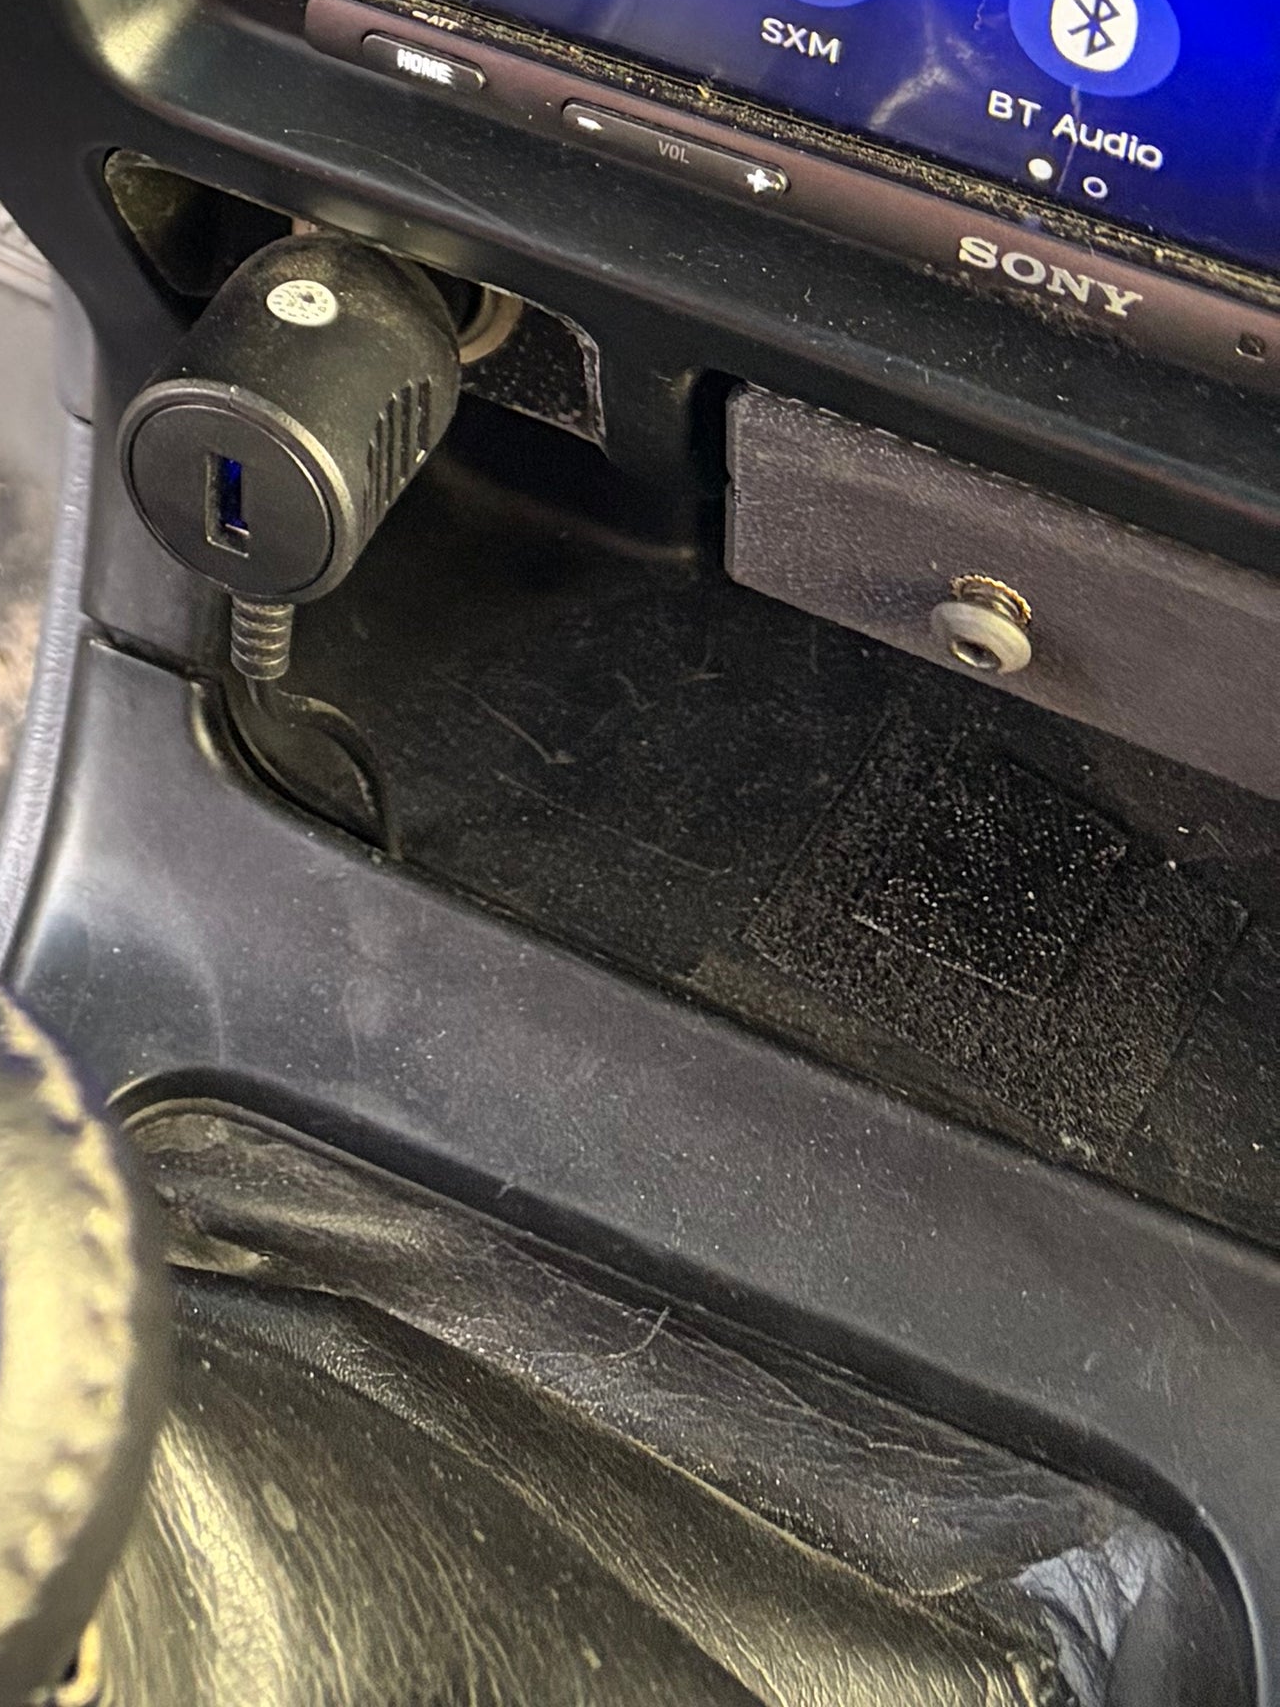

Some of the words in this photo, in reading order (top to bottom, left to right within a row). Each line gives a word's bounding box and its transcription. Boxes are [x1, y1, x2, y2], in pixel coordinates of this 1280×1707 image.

[760, 18, 842, 65] SXM
[396, 48, 453, 85] HOME
[657, 139, 691, 165] VOL
[987, 89, 1042, 131] BT
[1052, 111, 1165, 172] Audio
[958, 235, 1144, 319] SONY
